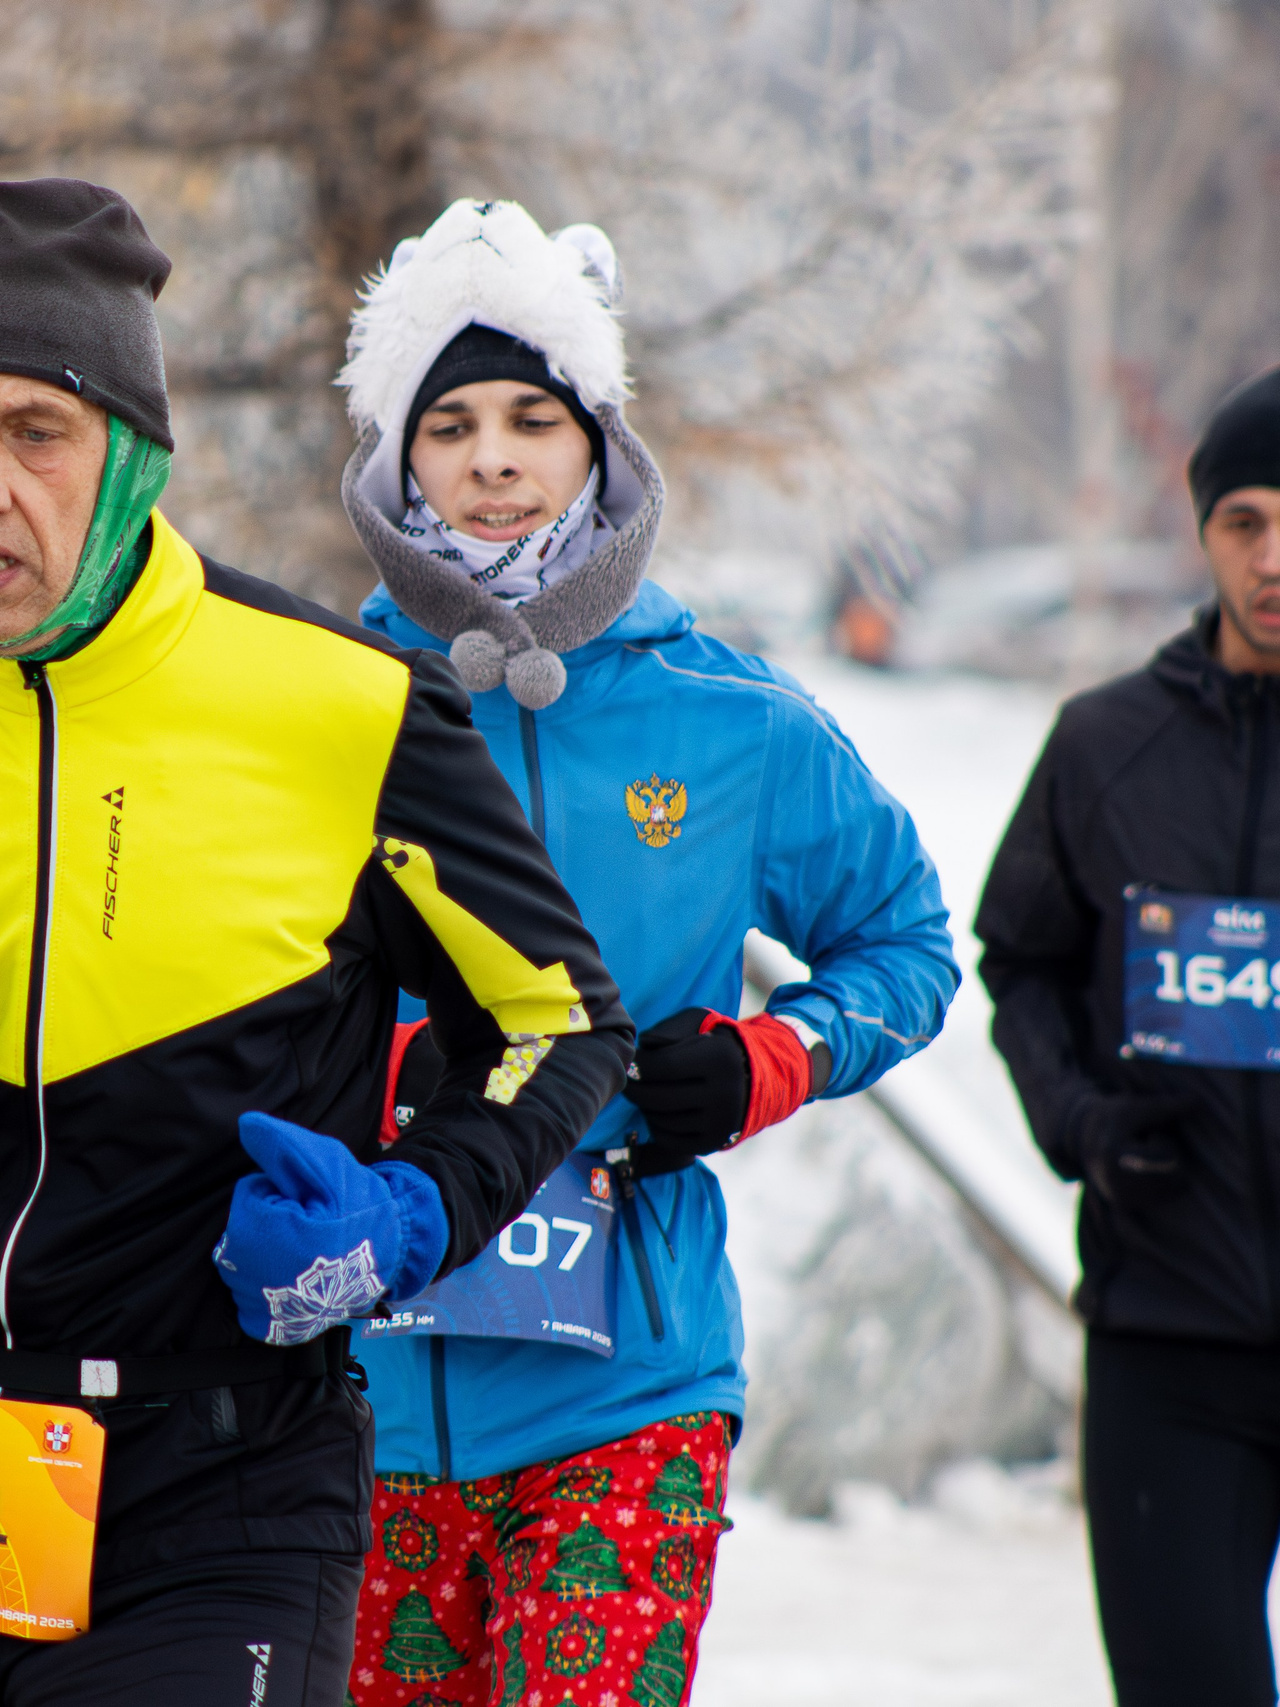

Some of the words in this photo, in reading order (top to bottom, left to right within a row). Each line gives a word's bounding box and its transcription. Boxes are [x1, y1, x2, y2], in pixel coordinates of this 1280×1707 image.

[102, 814, 123, 941] FISCHER
[1155, 949, 1280, 1011] 164
[497, 1211, 594, 1272] 07
[541, 1320, 550, 1331] 7
[38, 1614, 76, 1630] 2025
